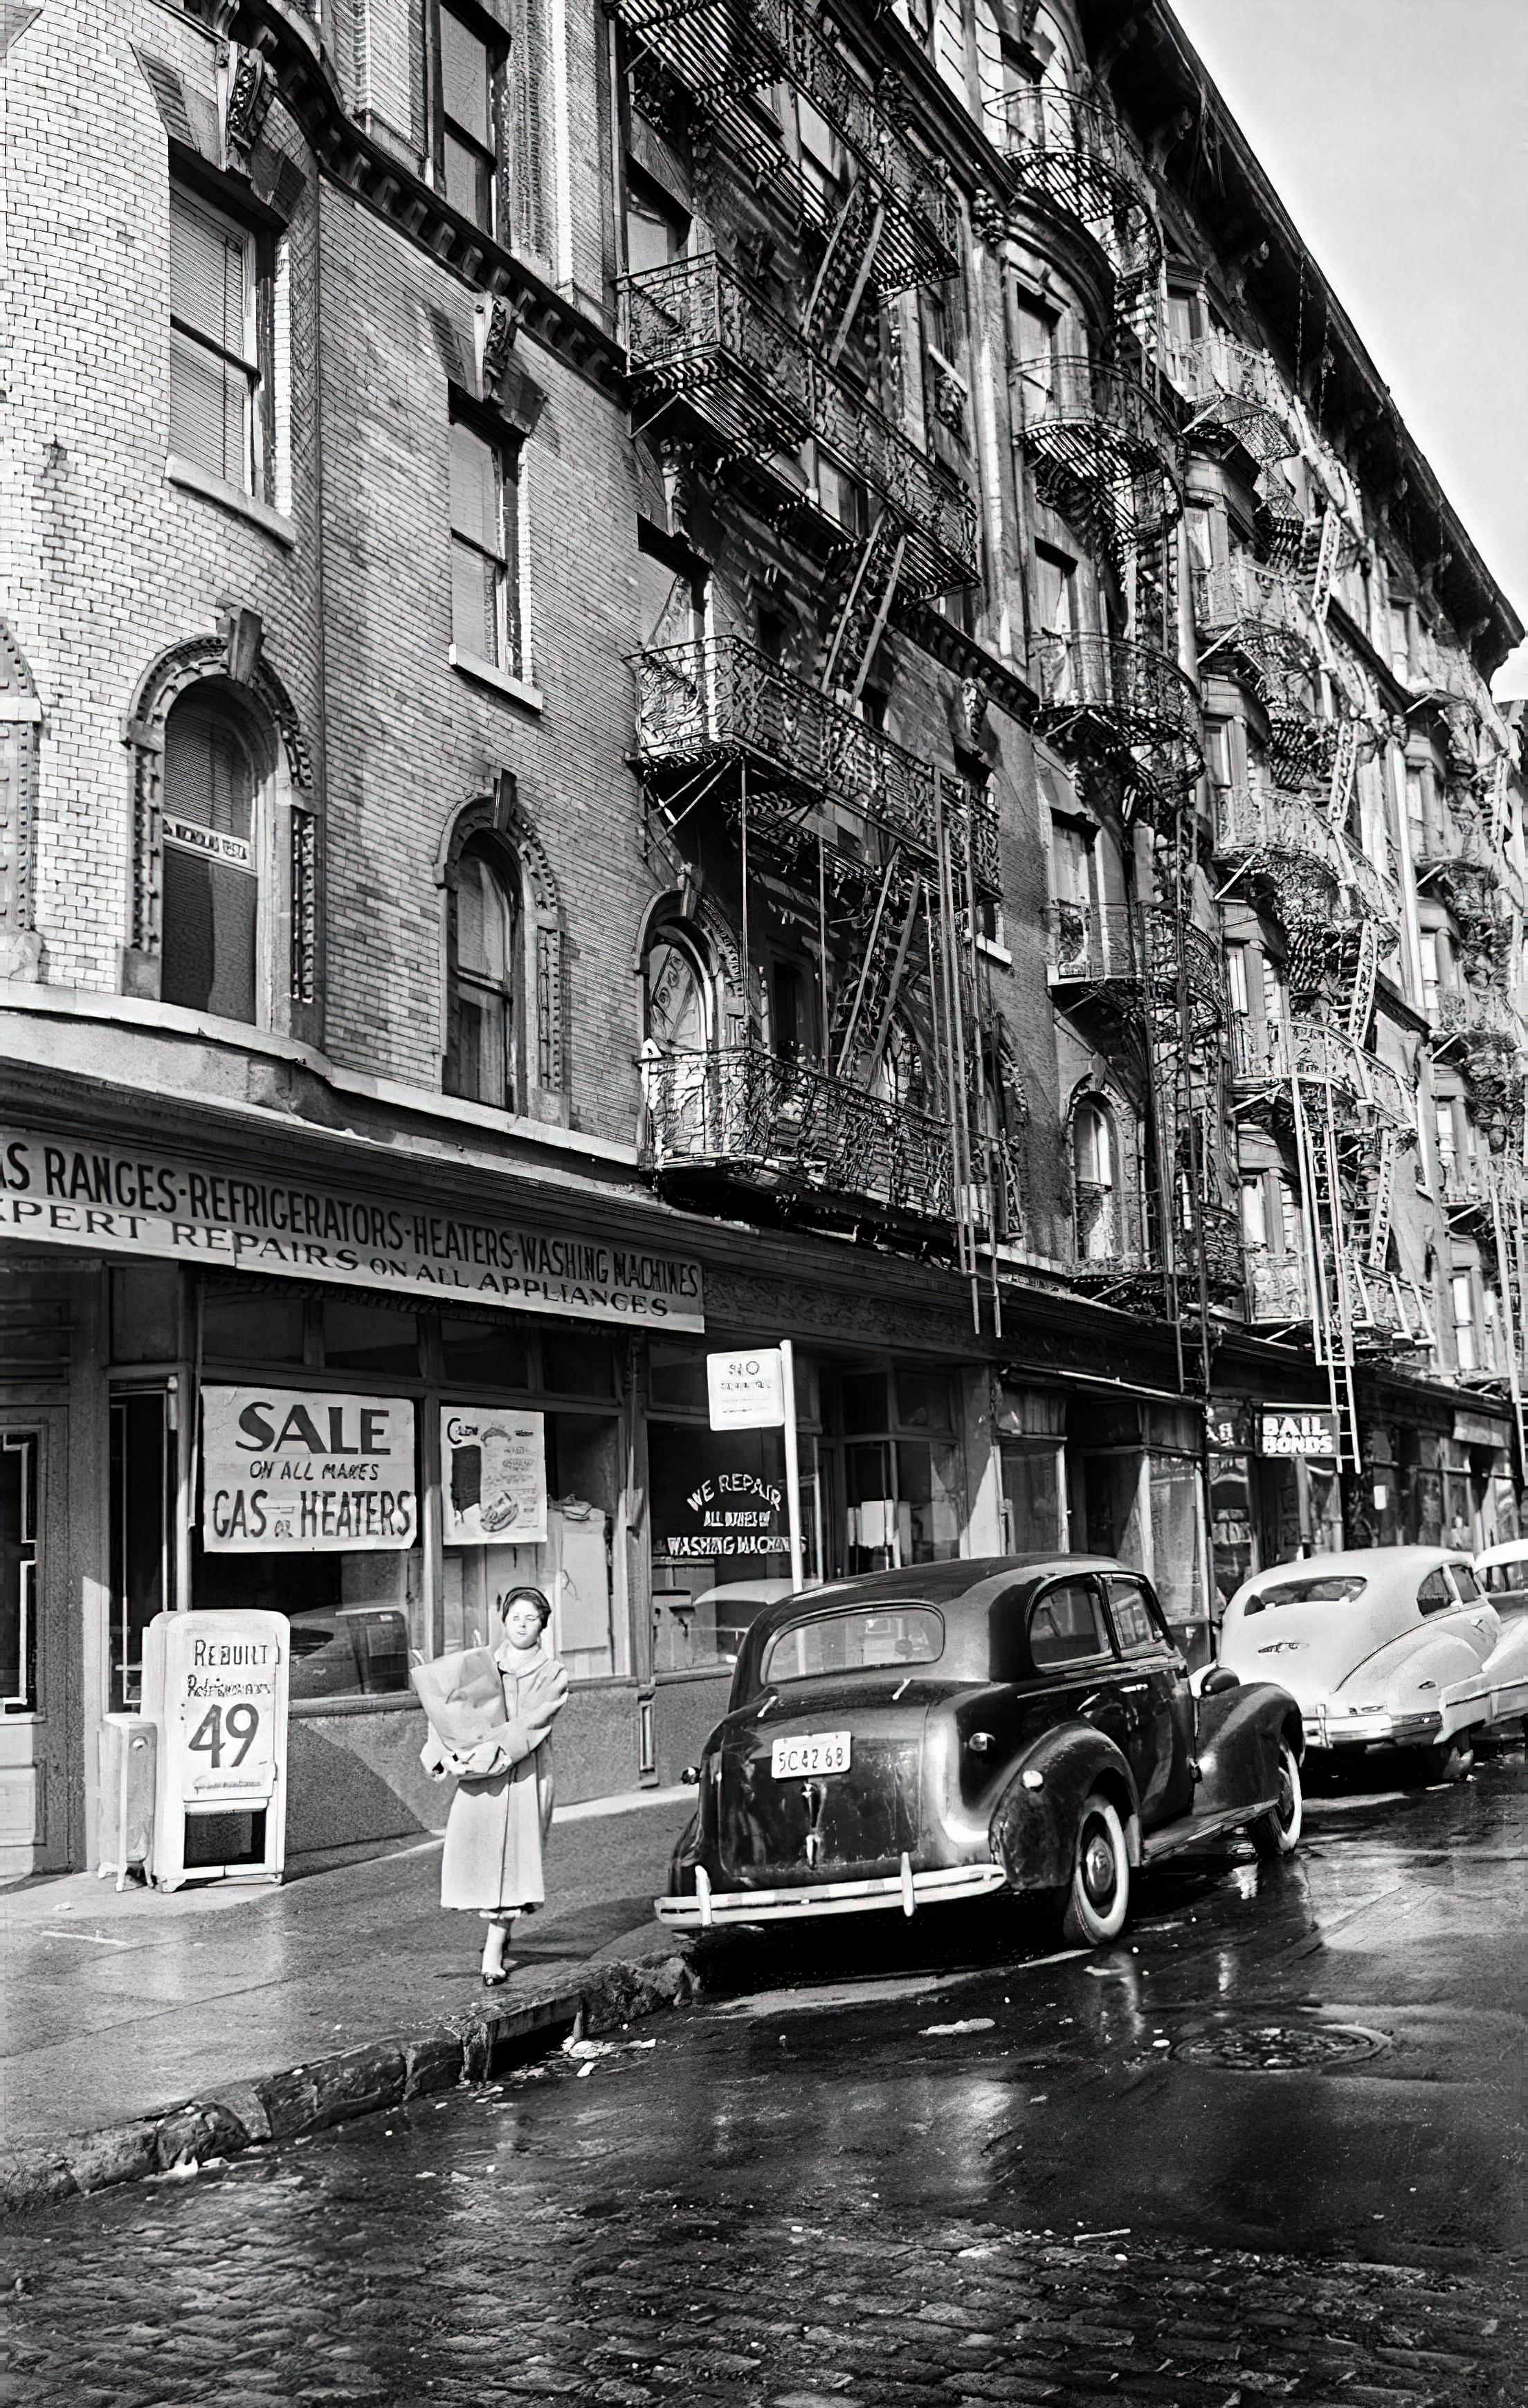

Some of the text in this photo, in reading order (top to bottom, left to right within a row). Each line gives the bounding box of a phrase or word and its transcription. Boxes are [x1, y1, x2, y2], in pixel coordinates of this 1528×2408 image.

[0, 1142, 698, 1297] S RANGES REFRIGERATORS HEATERS WASHING MACHINES
[0, 1198, 668, 1317] PERT REPAIRS ON ALL APPLIANCES
[235, 1401, 391, 1454] SALE
[1262, 1416, 1329, 1436] BAIL
[1262, 1434, 1334, 1454] BONDS
[249, 1460, 379, 1481] ON ALL MAKES
[686, 1472, 781, 1512] WE REPAIR
[212, 1489, 268, 1538] GAS
[300, 1490, 412, 1538] HEATERS
[194, 1639, 269, 1667] REBUILT
[188, 1703, 260, 1769] 49
